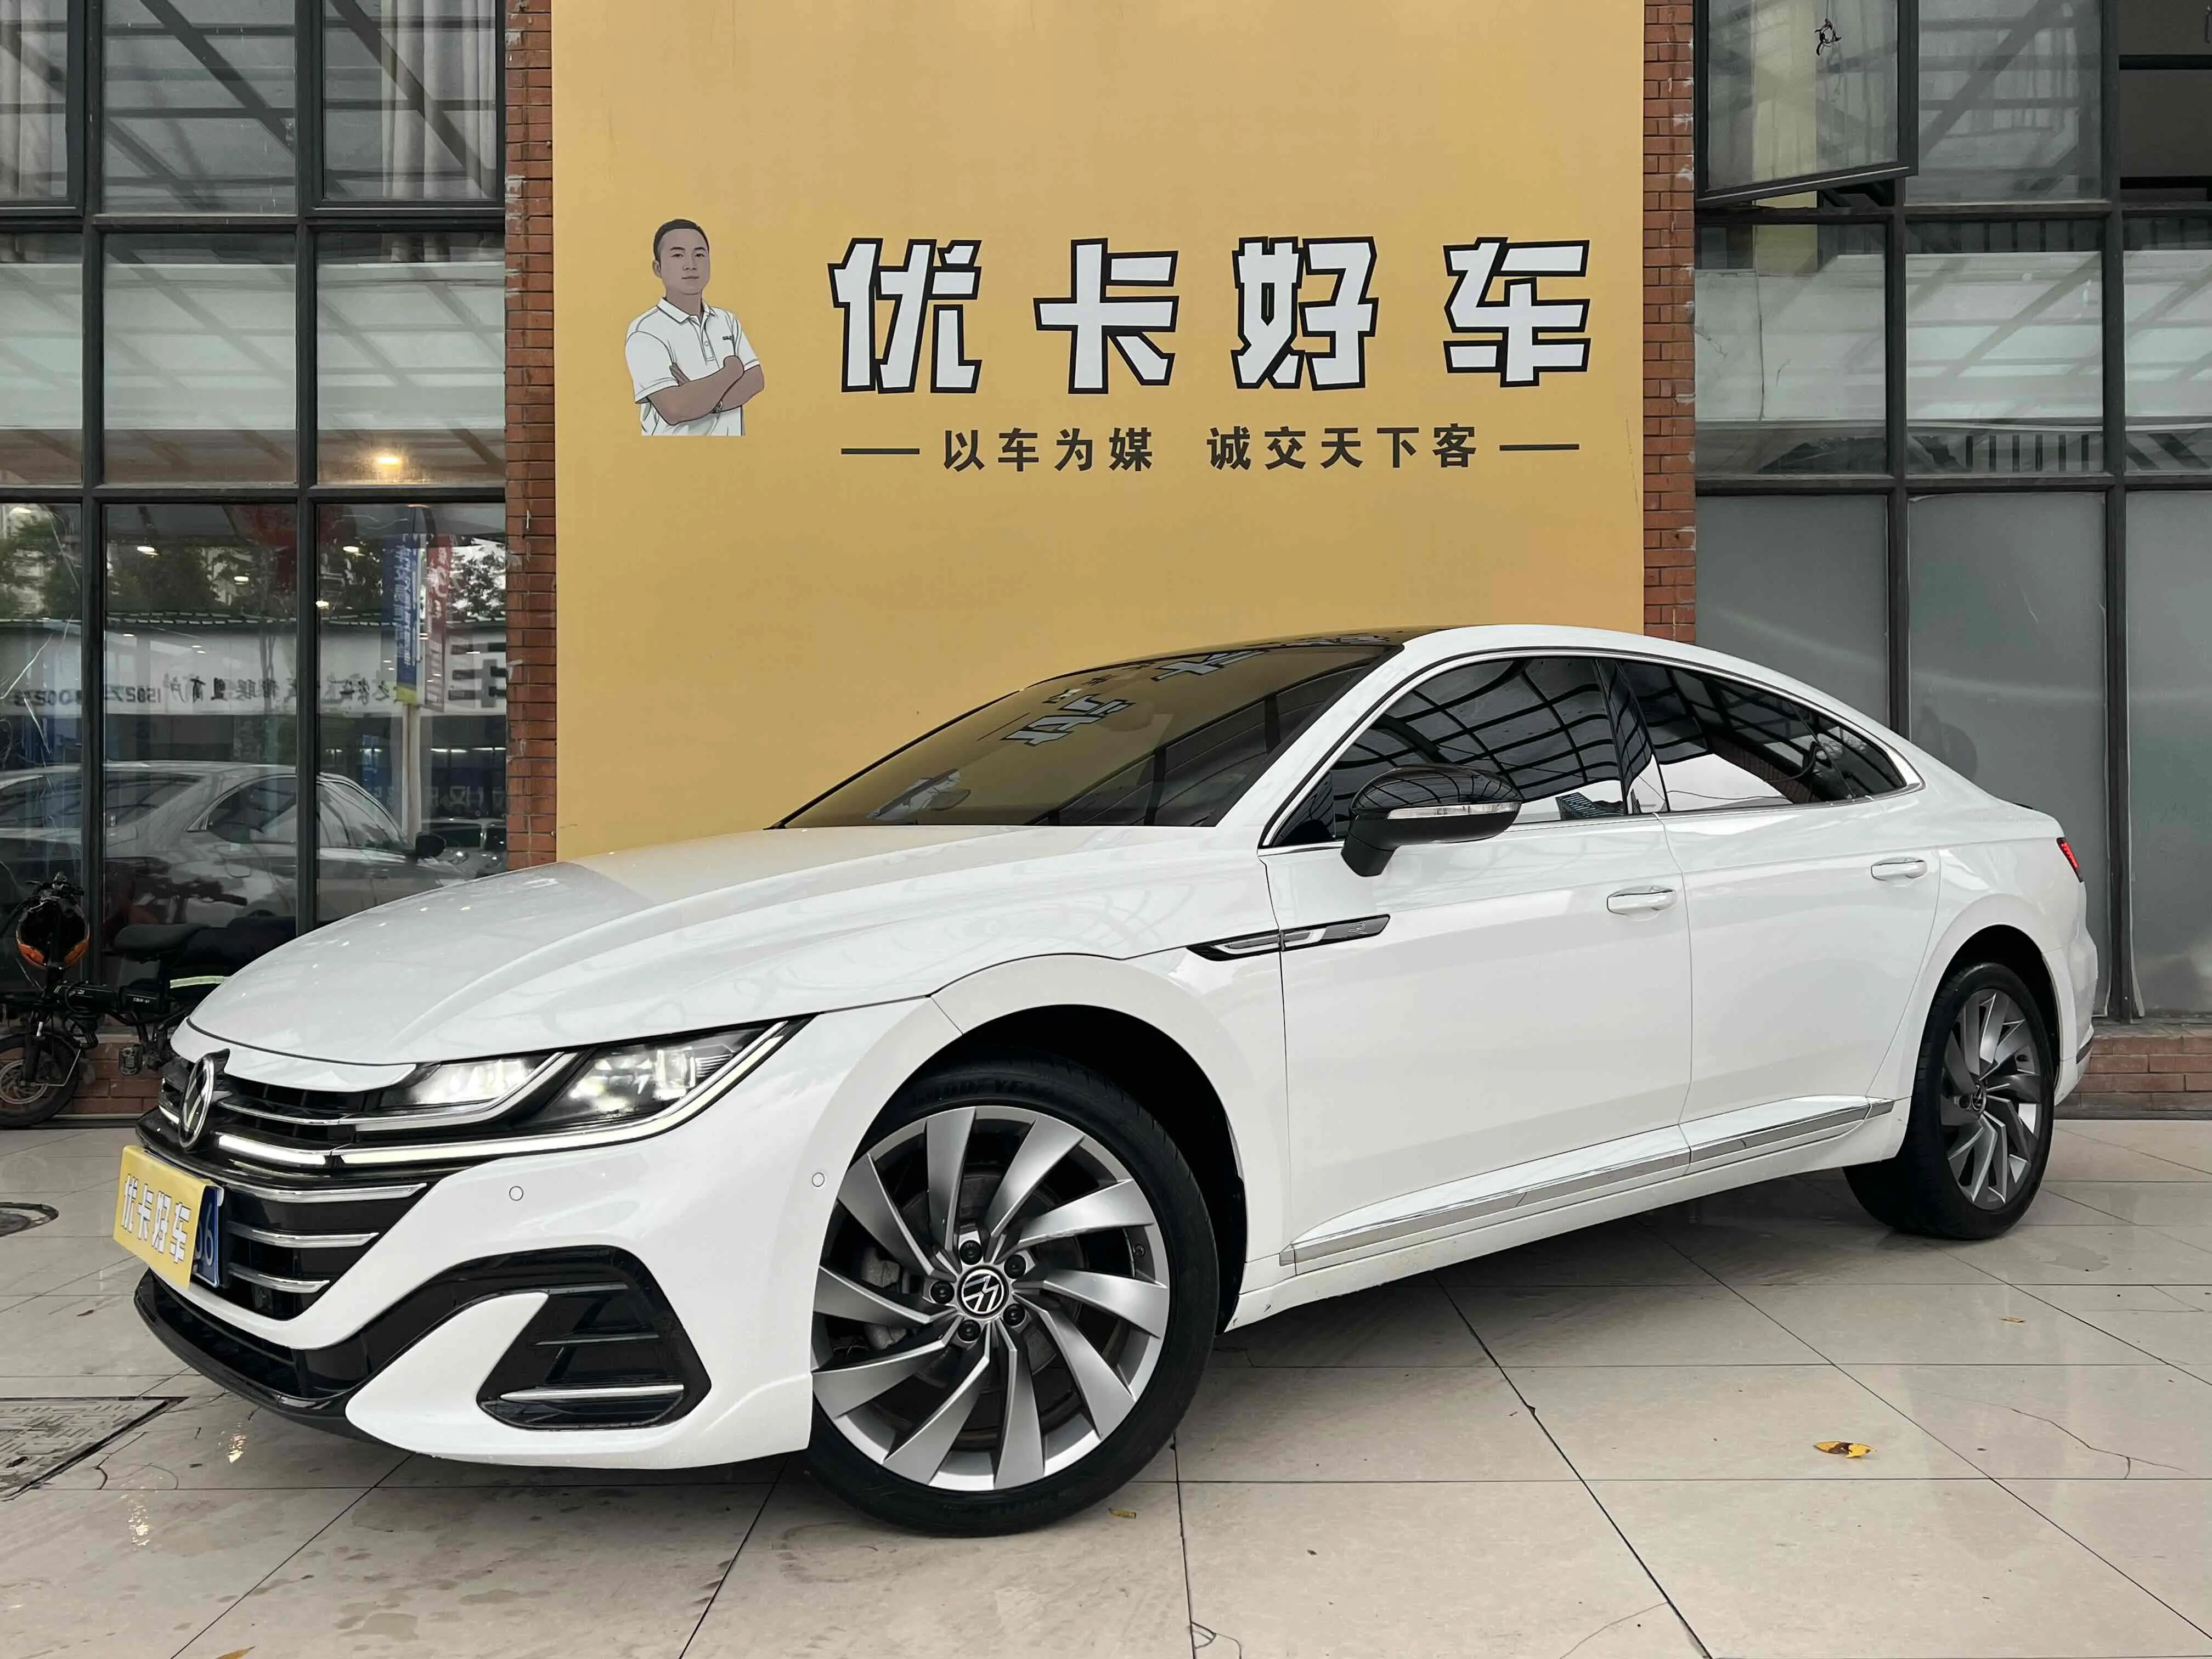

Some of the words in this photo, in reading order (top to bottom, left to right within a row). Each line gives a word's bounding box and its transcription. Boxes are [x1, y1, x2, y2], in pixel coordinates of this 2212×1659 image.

[827, 236, 1590, 394] 优卡好车
[943, 427, 1153, 472] 以车为媒
[1206, 423, 1477, 471] 诚交天下客
[121, 1173, 191, 1264] 优卡好车
